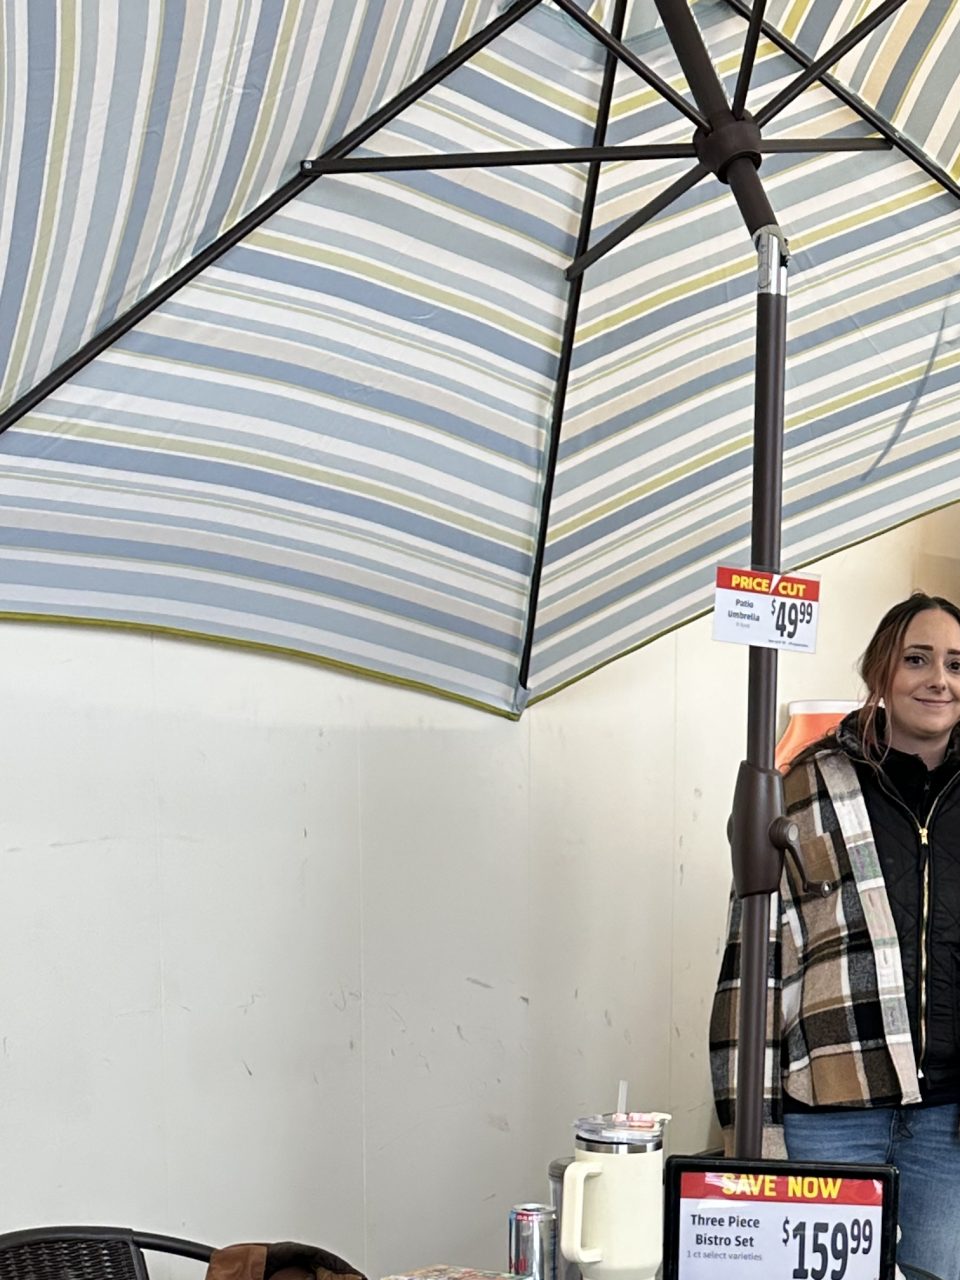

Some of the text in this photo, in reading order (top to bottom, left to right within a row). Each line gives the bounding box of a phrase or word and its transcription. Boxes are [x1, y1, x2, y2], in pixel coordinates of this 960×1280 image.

[731, 574, 807, 597] PRICE CUT
[735, 598, 754, 609] Patio
[727, 610, 760, 622] Umbrella
[722, 1174, 842, 1199] SAVE NOW
[690, 1214, 760, 1228] Three Piece
[695, 1233, 754, 1248] Bistro Set
[703, 1251, 727, 1259] select
[728, 1253, 762, 1261] varieties
